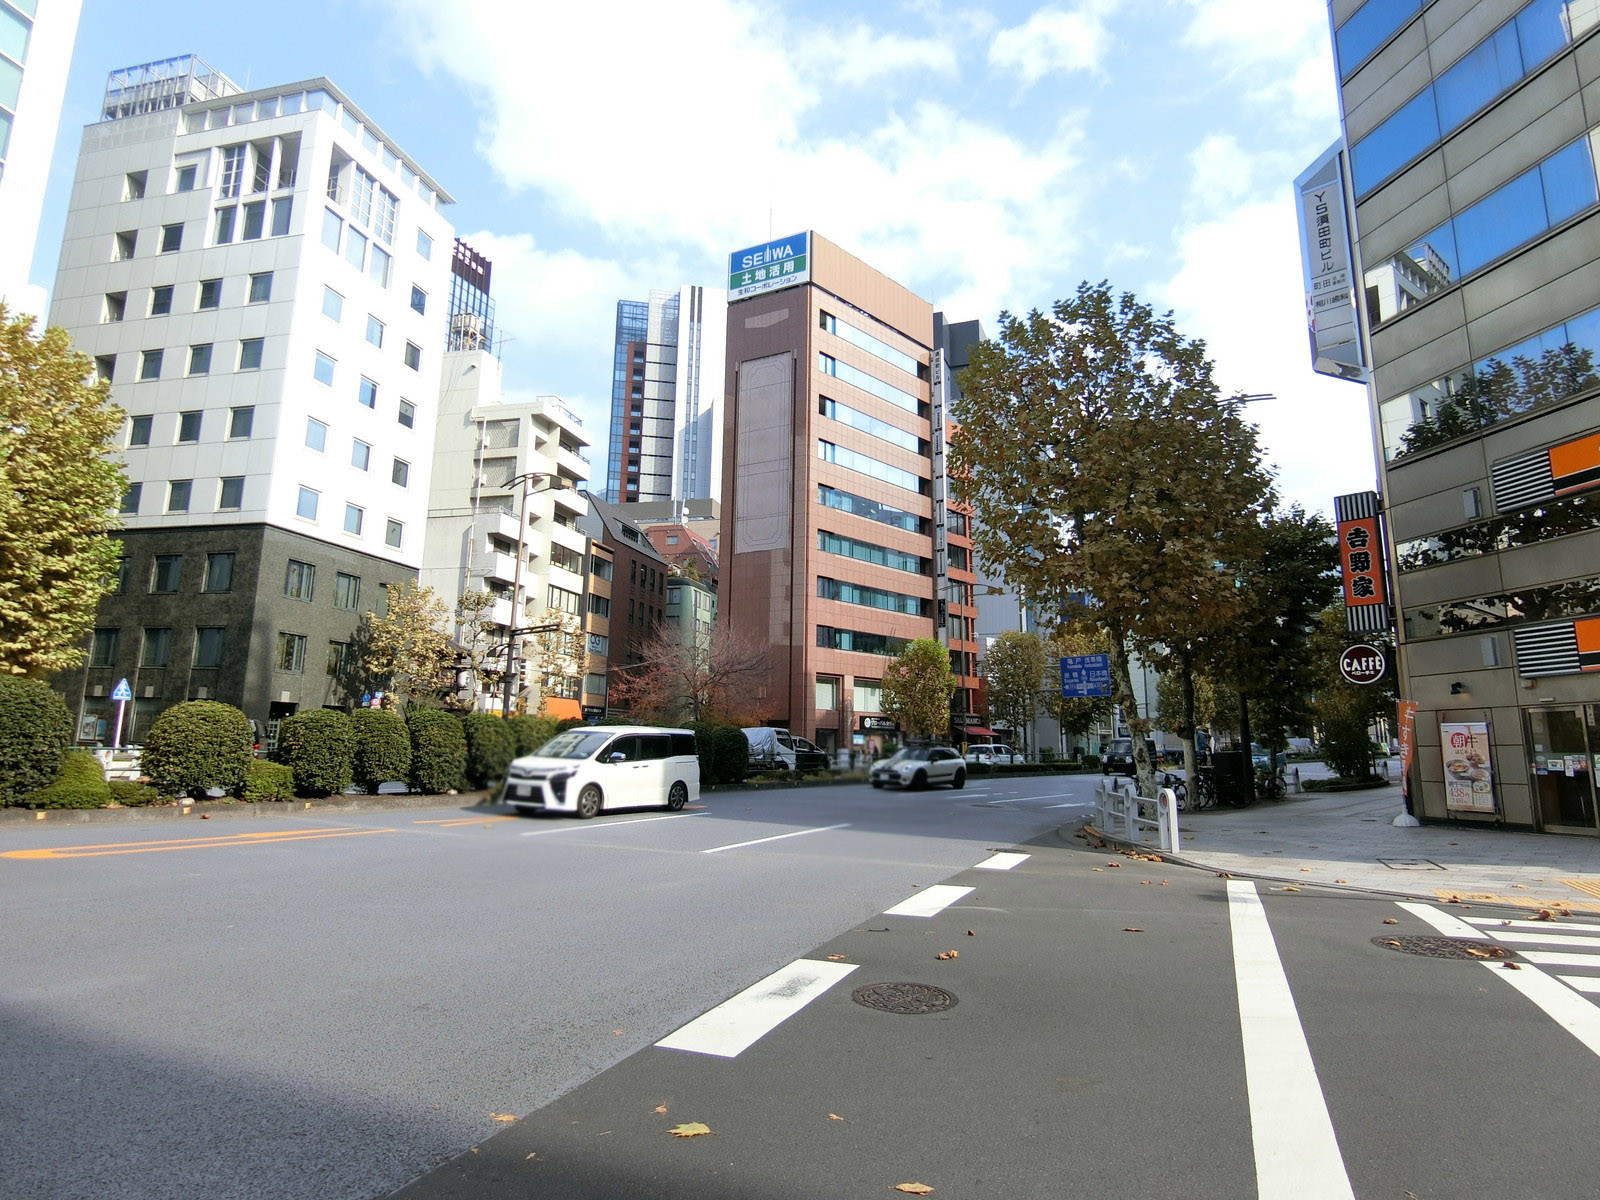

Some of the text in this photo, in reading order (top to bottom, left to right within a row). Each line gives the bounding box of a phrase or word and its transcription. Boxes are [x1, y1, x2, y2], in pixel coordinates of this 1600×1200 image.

[742, 245, 793, 268] SEIWA
[741, 261, 794, 285] 土地活用
[738, 275, 797, 296] 生和コーポレーション
[1345, 526, 1375, 598] 吉野家
